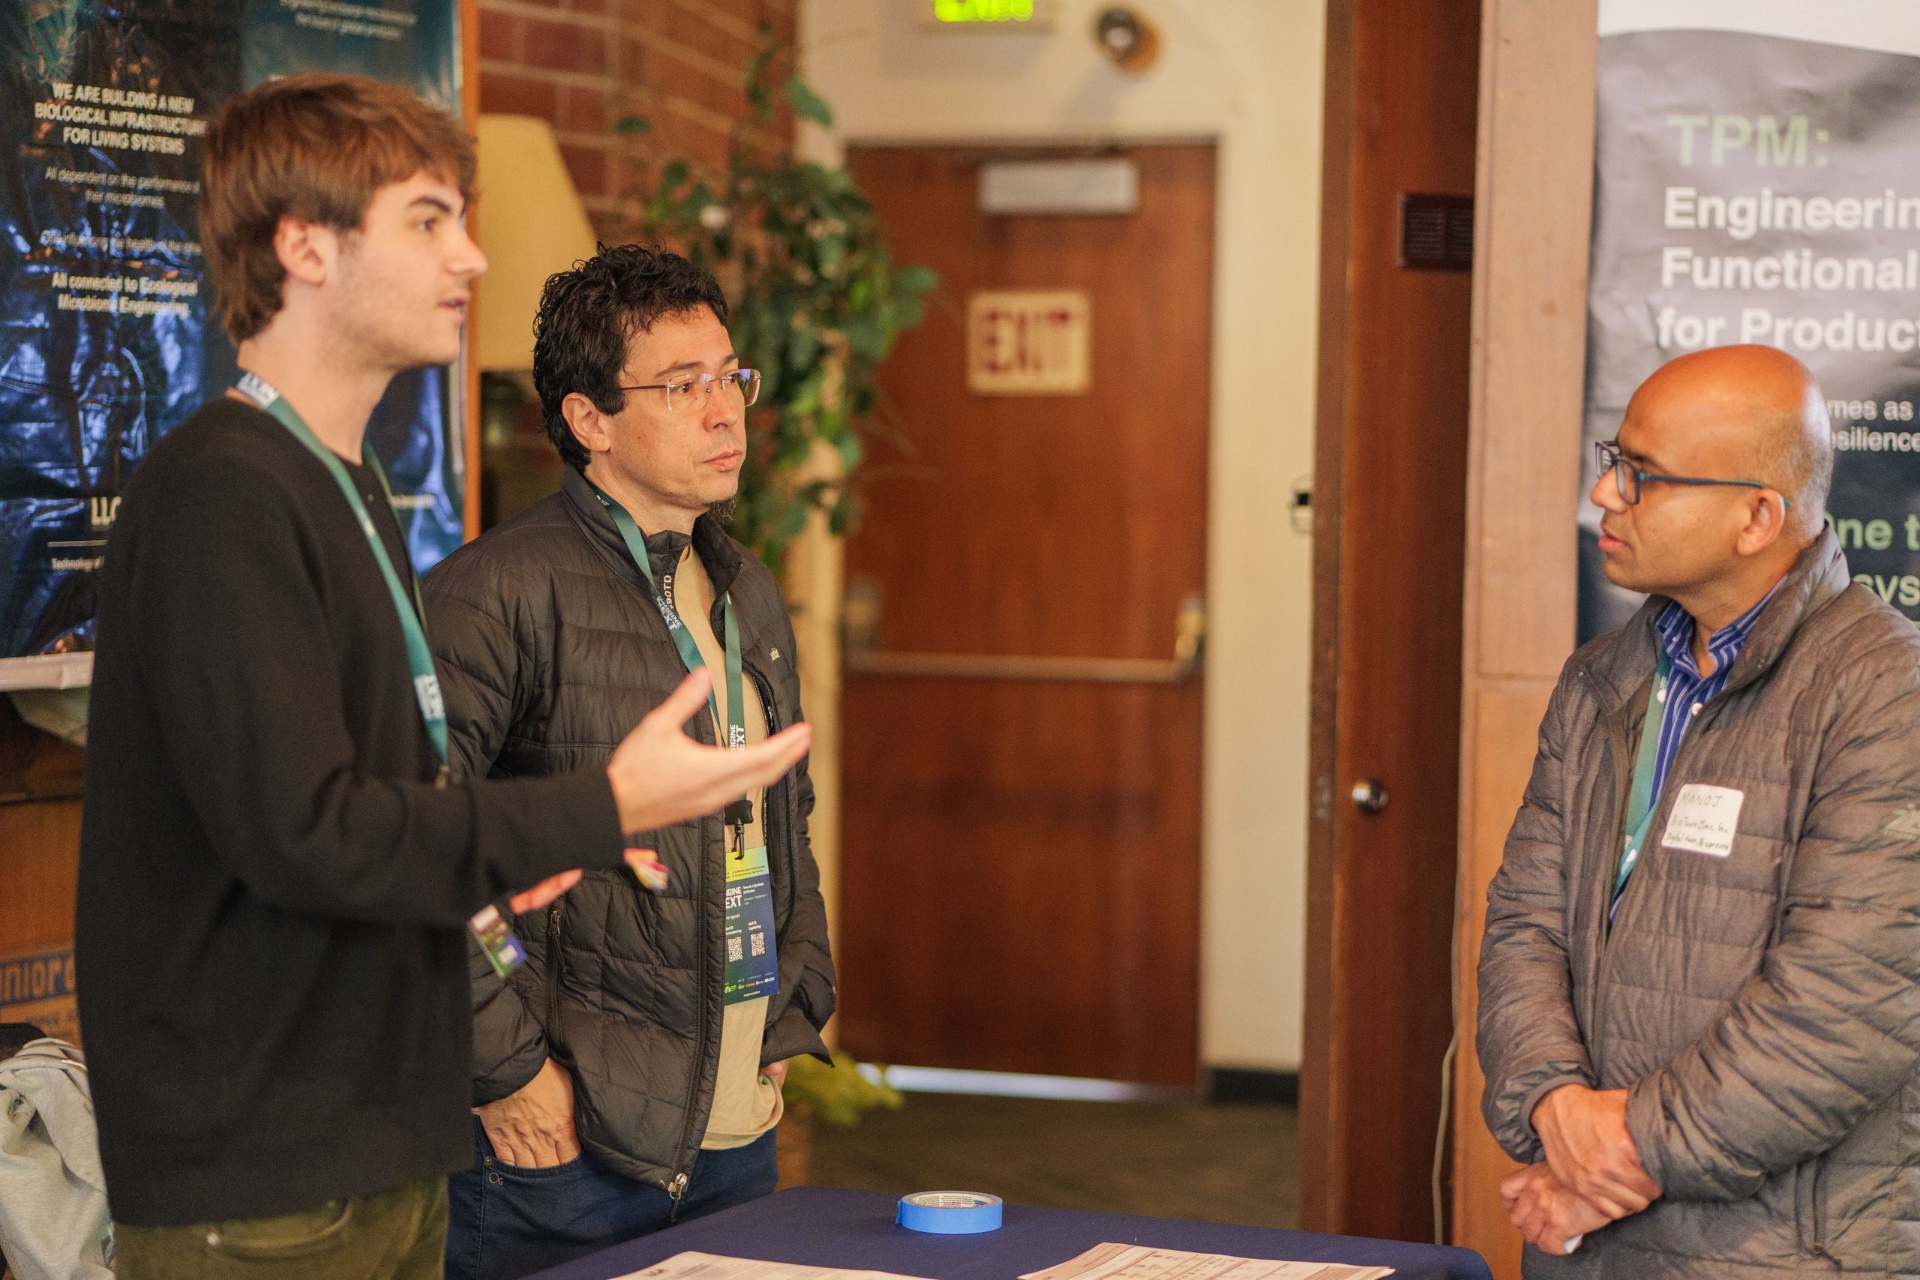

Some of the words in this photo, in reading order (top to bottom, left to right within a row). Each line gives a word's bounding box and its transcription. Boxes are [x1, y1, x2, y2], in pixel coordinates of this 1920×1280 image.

[52, 82, 73, 100] WE
[75, 85, 101, 102] ARE
[101, 87, 157, 111] BUILDING
[168, 96, 195, 115] NEW
[34, 102, 108, 126] BIOLOGICAL
[109, 110, 207, 136] INFRASTRUCTUR
[63, 126, 91, 145] FOR
[91, 129, 130, 149] LIVING
[130, 133, 186, 155] SYSTEMS
[1667, 114, 1830, 167] TPM:
[1664, 186, 1920, 240] Engineerin
[52, 271, 68, 289] All
[69, 275, 123, 292] connected
[124, 276, 138, 294] to
[139, 276, 198, 299] Ecological
[1661, 247, 1919, 290] Functional
[1656, 305, 1726, 350] for
[1883, 400, 1914, 422] as
[1831, 426, 1920, 453] silience
[1824, 511, 1893, 551] ne
